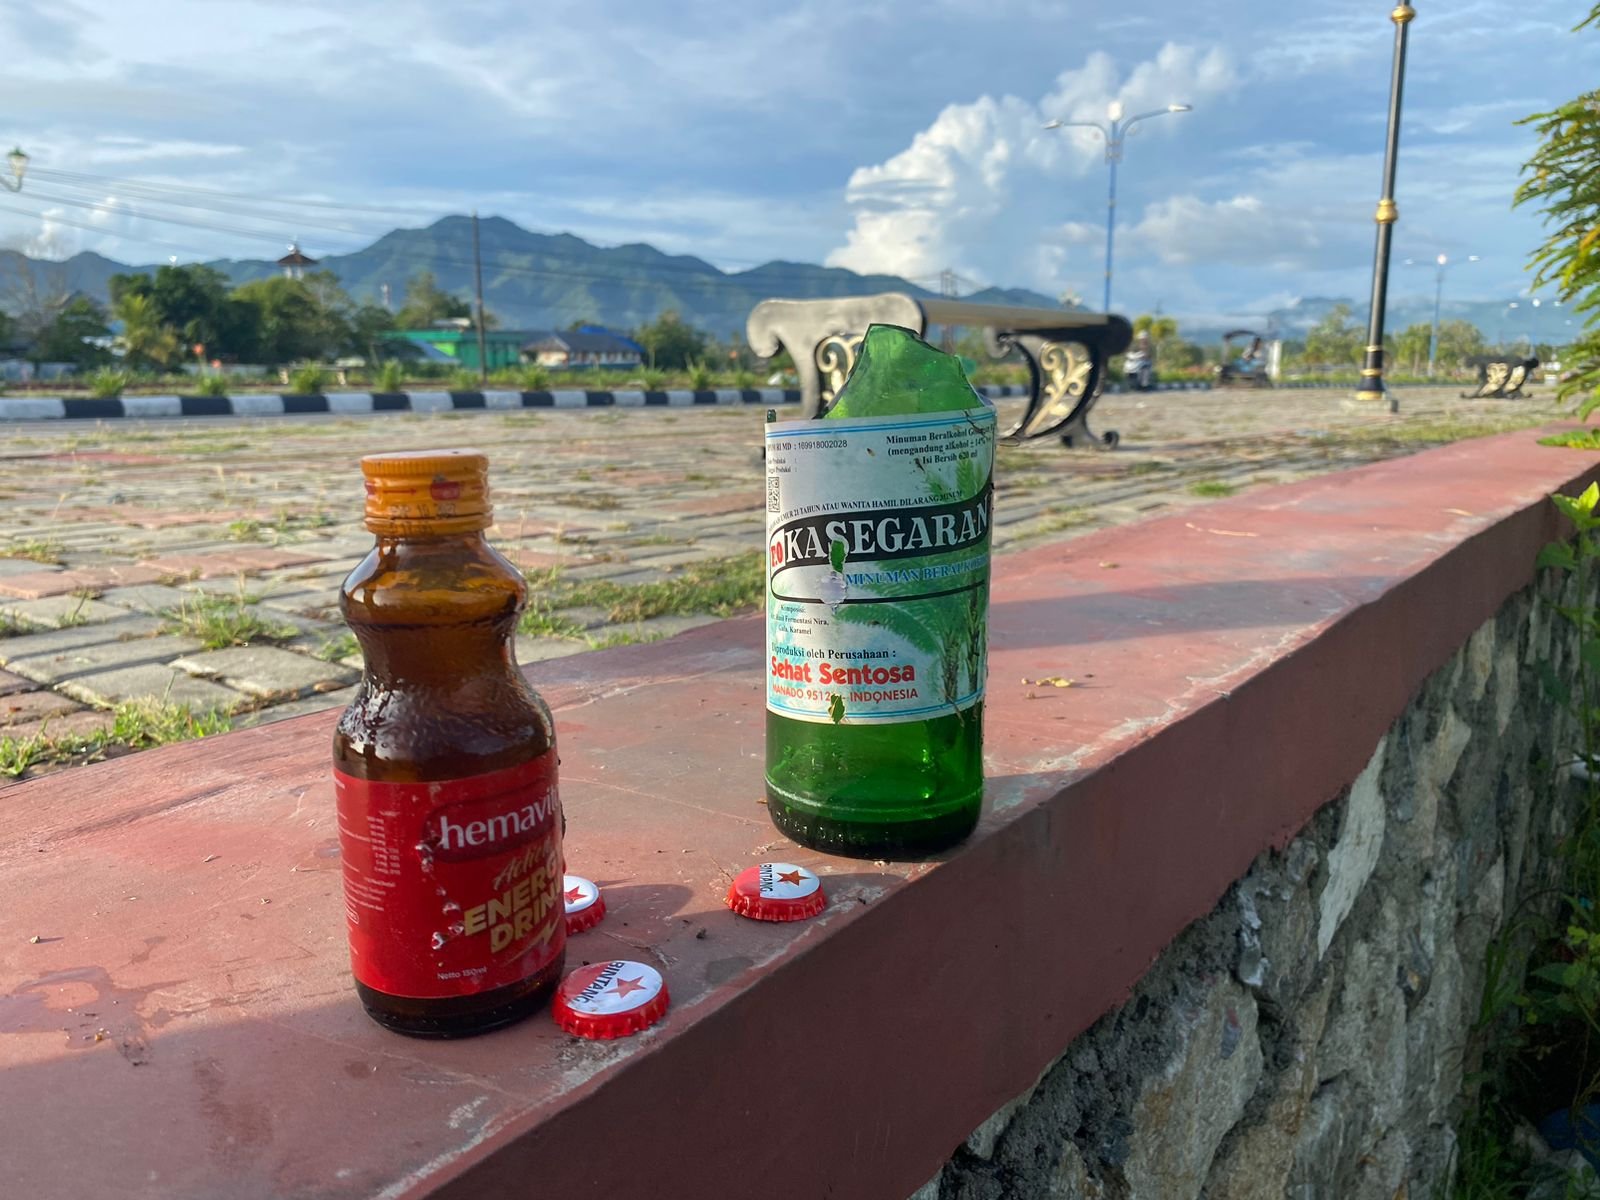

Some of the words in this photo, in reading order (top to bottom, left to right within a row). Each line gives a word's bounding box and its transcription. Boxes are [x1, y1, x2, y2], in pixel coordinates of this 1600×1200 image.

[798, 439, 848, 450] 169918002028
[886, 434, 927, 445] Minuman
[888, 444, 943, 456] (mengandung
[922, 455, 932, 464] Isi
[934, 453, 957, 463] Bersih
[800, 504, 820, 514] TAHUN
[821, 502, 840, 511] ATAU
[841, 500, 871, 509] WANITA
[872, 499, 899, 508] HAMIL
[900, 495, 939, 506] DILARANG
[785, 493, 988, 563] KASEGARAN
[845, 569, 921, 585] MINUMAN
[790, 626, 812, 635] Karamel
[806, 648, 825, 659] oleh
[828, 649, 889, 660] Perusahaan
[771, 655, 813, 684] Sehat
[819, 662, 916, 685] Sentosa
[773, 683, 804, 699] MANADO
[806, 688, 837, 702] 9512
[850, 688, 919, 703] INDONESIA
[759, 863, 774, 892] BINTANG
[573, 961, 626, 1004] BINTANG
